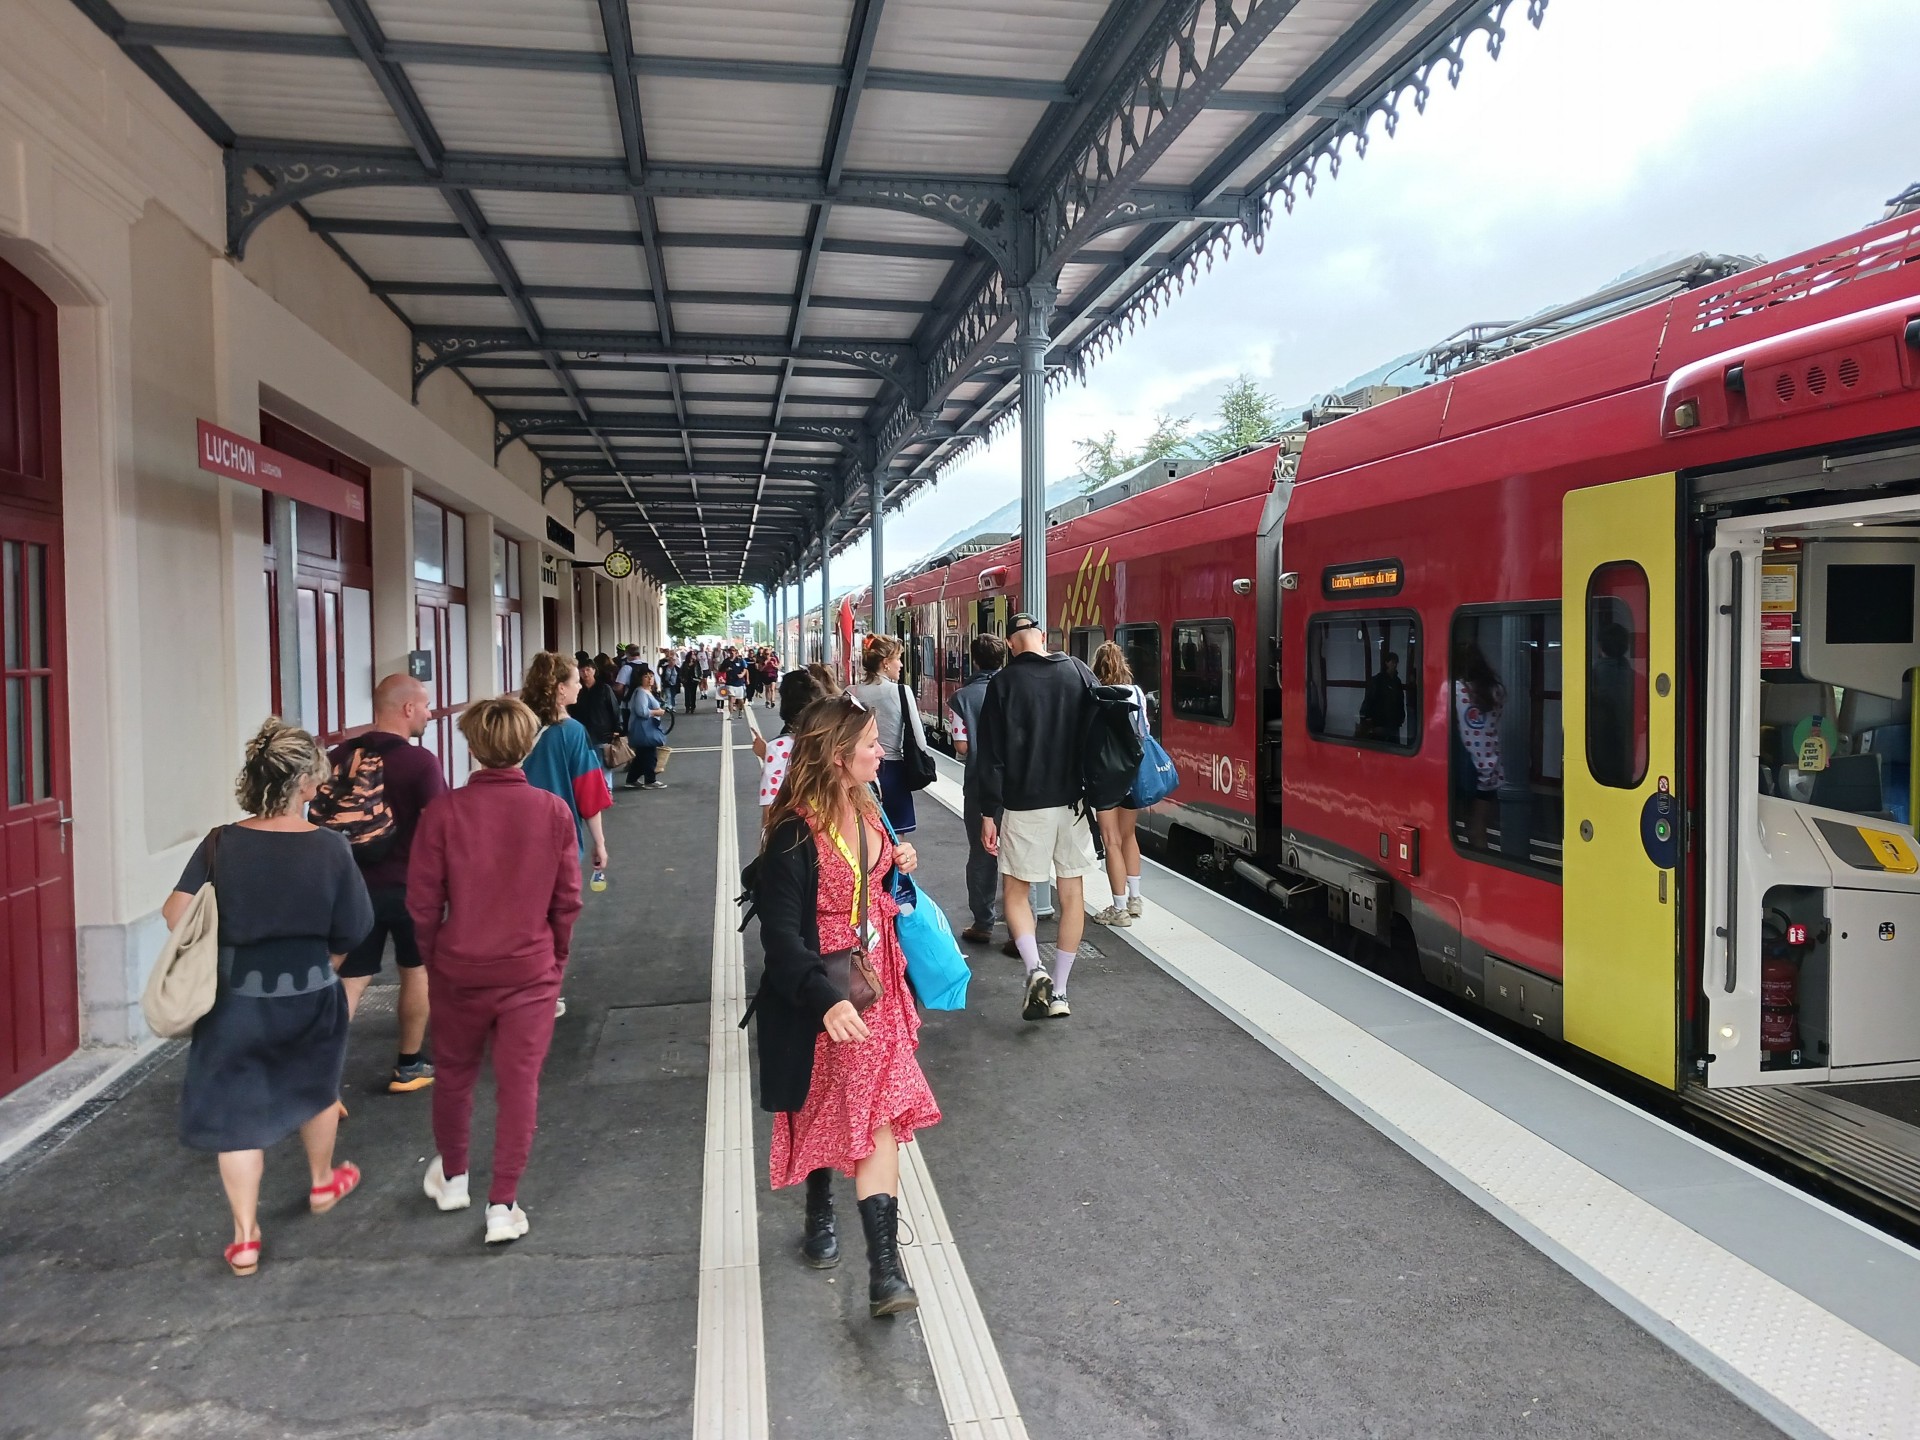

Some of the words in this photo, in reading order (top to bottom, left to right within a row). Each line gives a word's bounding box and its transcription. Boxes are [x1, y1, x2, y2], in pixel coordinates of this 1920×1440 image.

[205, 432, 256, 475] LUCHON
[1353, 573, 1375, 586] terminus
[1376, 571, 1384, 584] du
